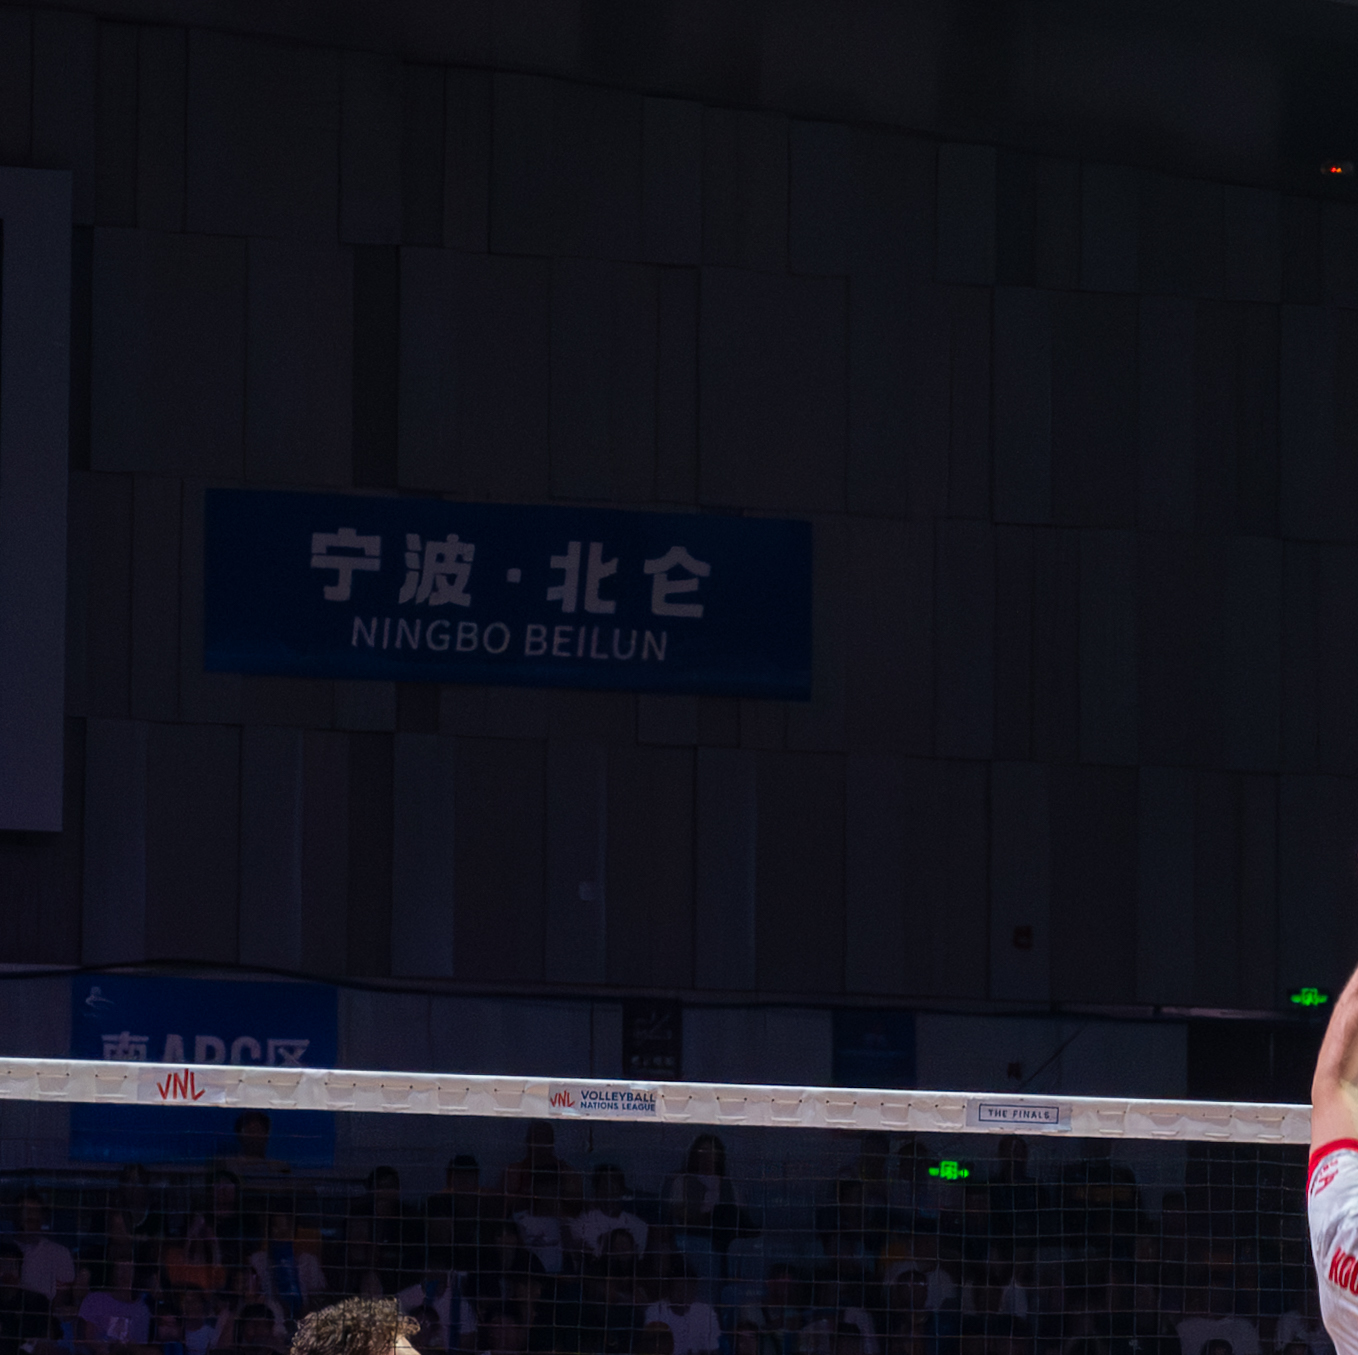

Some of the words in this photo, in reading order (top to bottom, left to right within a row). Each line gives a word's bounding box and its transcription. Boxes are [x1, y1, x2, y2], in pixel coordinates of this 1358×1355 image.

[310, 526, 712, 619] 宁波·北仑
[350, 615, 511, 655] NINGBO
[523, 623, 669, 661] BEILUN
[157, 1068, 205, 1101] VNL
[550, 1090, 576, 1108] VNL
[580, 1090, 656, 1103] VOLLEYBALL
[580, 1101, 619, 1110] NATIONS
[622, 1103, 656, 1112] LEAGUE
[988, 1108, 1008, 1119] THE
[1012, 1110, 1050, 1119] FINALS
